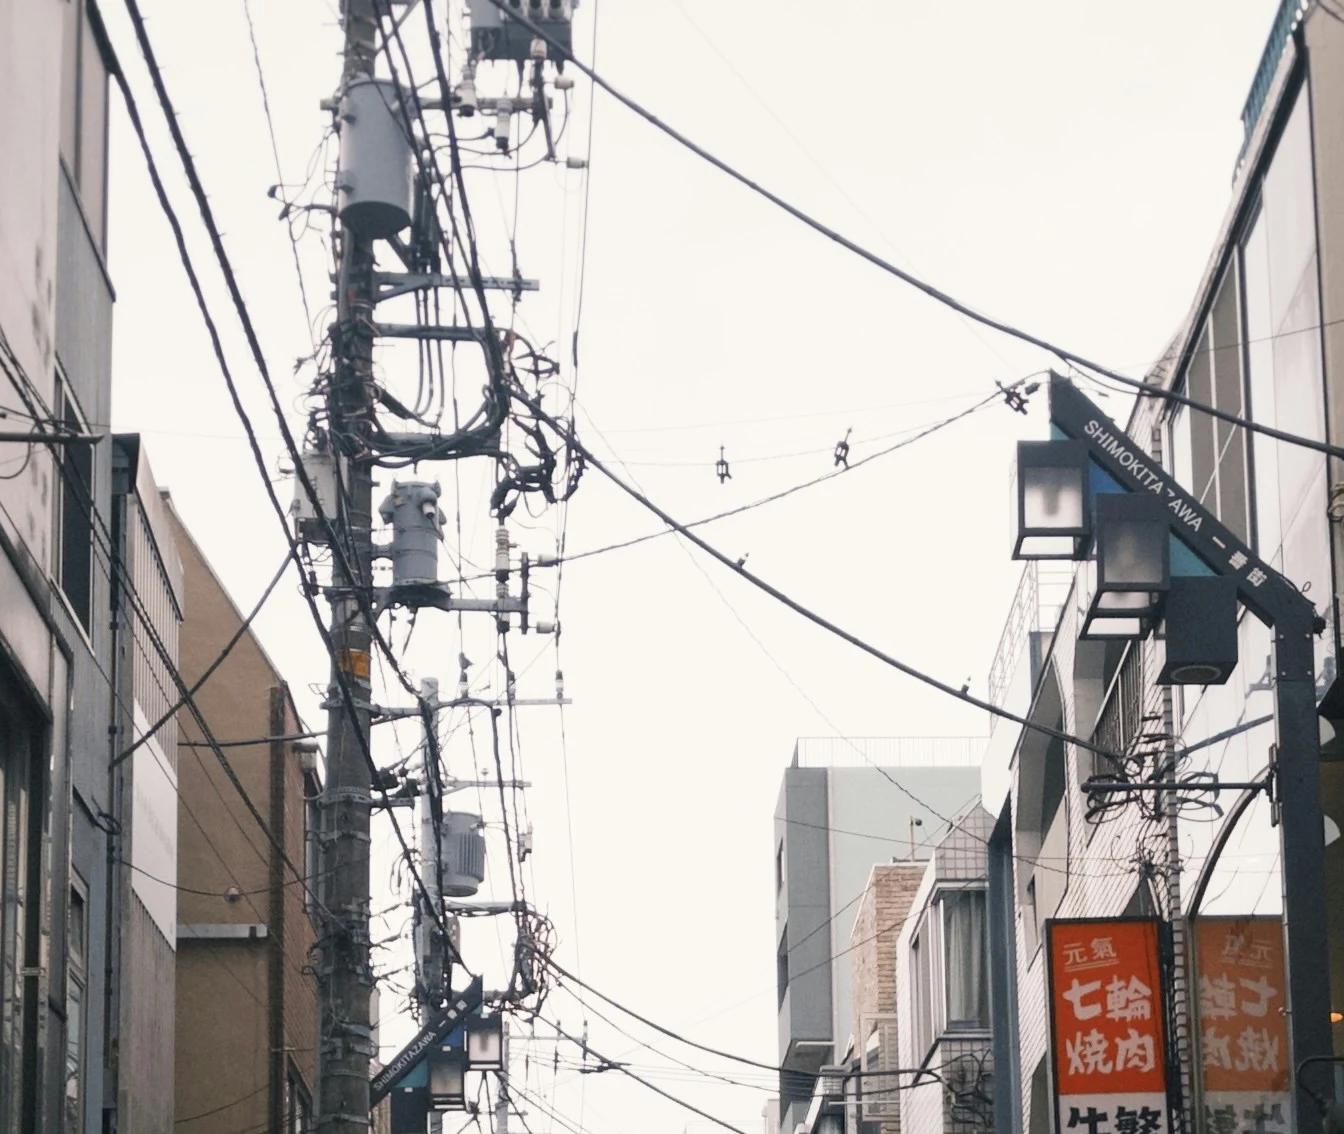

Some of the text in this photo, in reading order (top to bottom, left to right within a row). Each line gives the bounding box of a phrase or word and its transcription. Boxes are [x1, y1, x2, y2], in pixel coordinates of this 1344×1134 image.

[1063, 974, 1152, 1021] 七輪
[373, 1030, 437, 1092] SHIMOKITAZAWA
[1066, 1028, 1155, 1075] 焼肉
